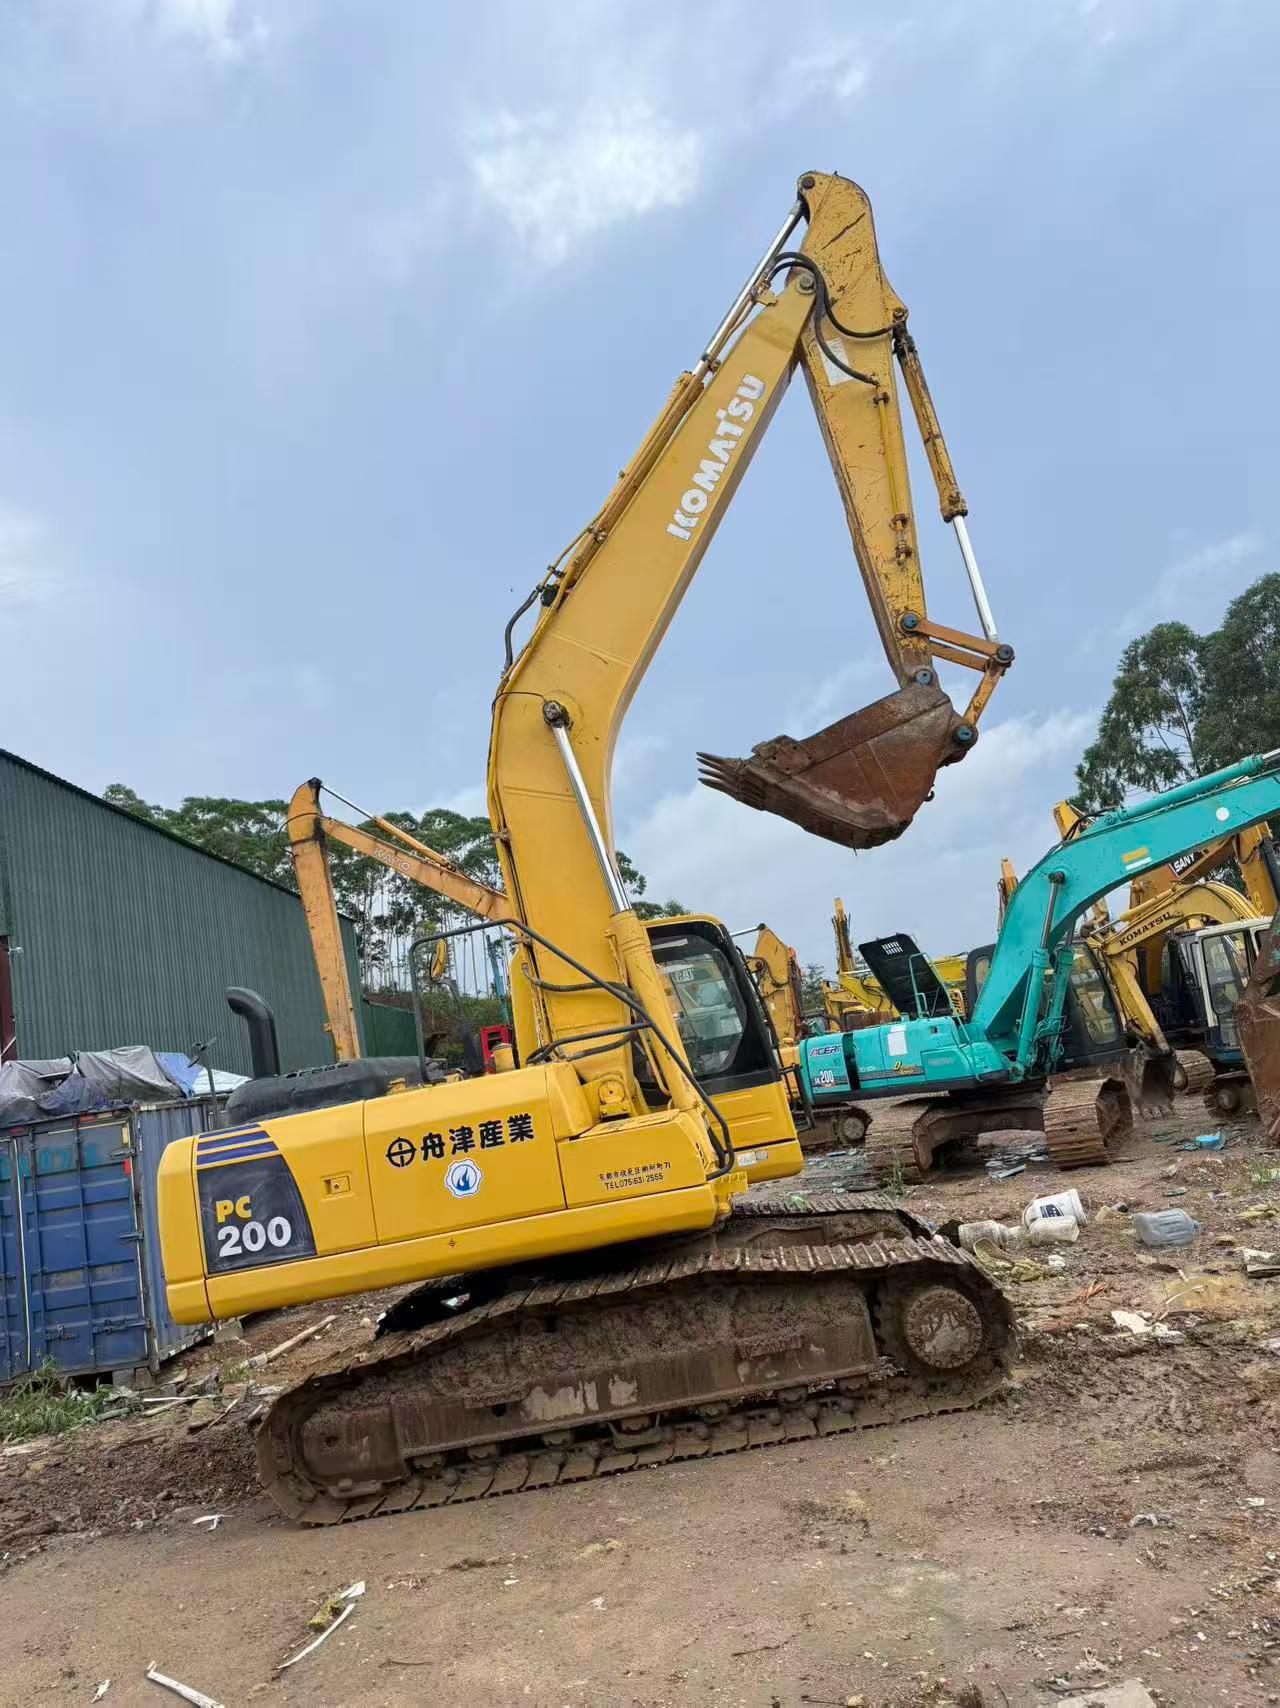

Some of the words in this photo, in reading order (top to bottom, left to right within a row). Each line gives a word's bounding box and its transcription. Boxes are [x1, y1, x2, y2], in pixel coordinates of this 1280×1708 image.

[665, 374, 767, 541] KOMATSU
[1173, 852, 1195, 873] SANY
[1119, 911, 1171, 946] KOMATSU
[420, 1113, 535, 1162] 舟津産業
[215, 1195, 252, 1223] PC
[217, 1216, 292, 1257] 200
